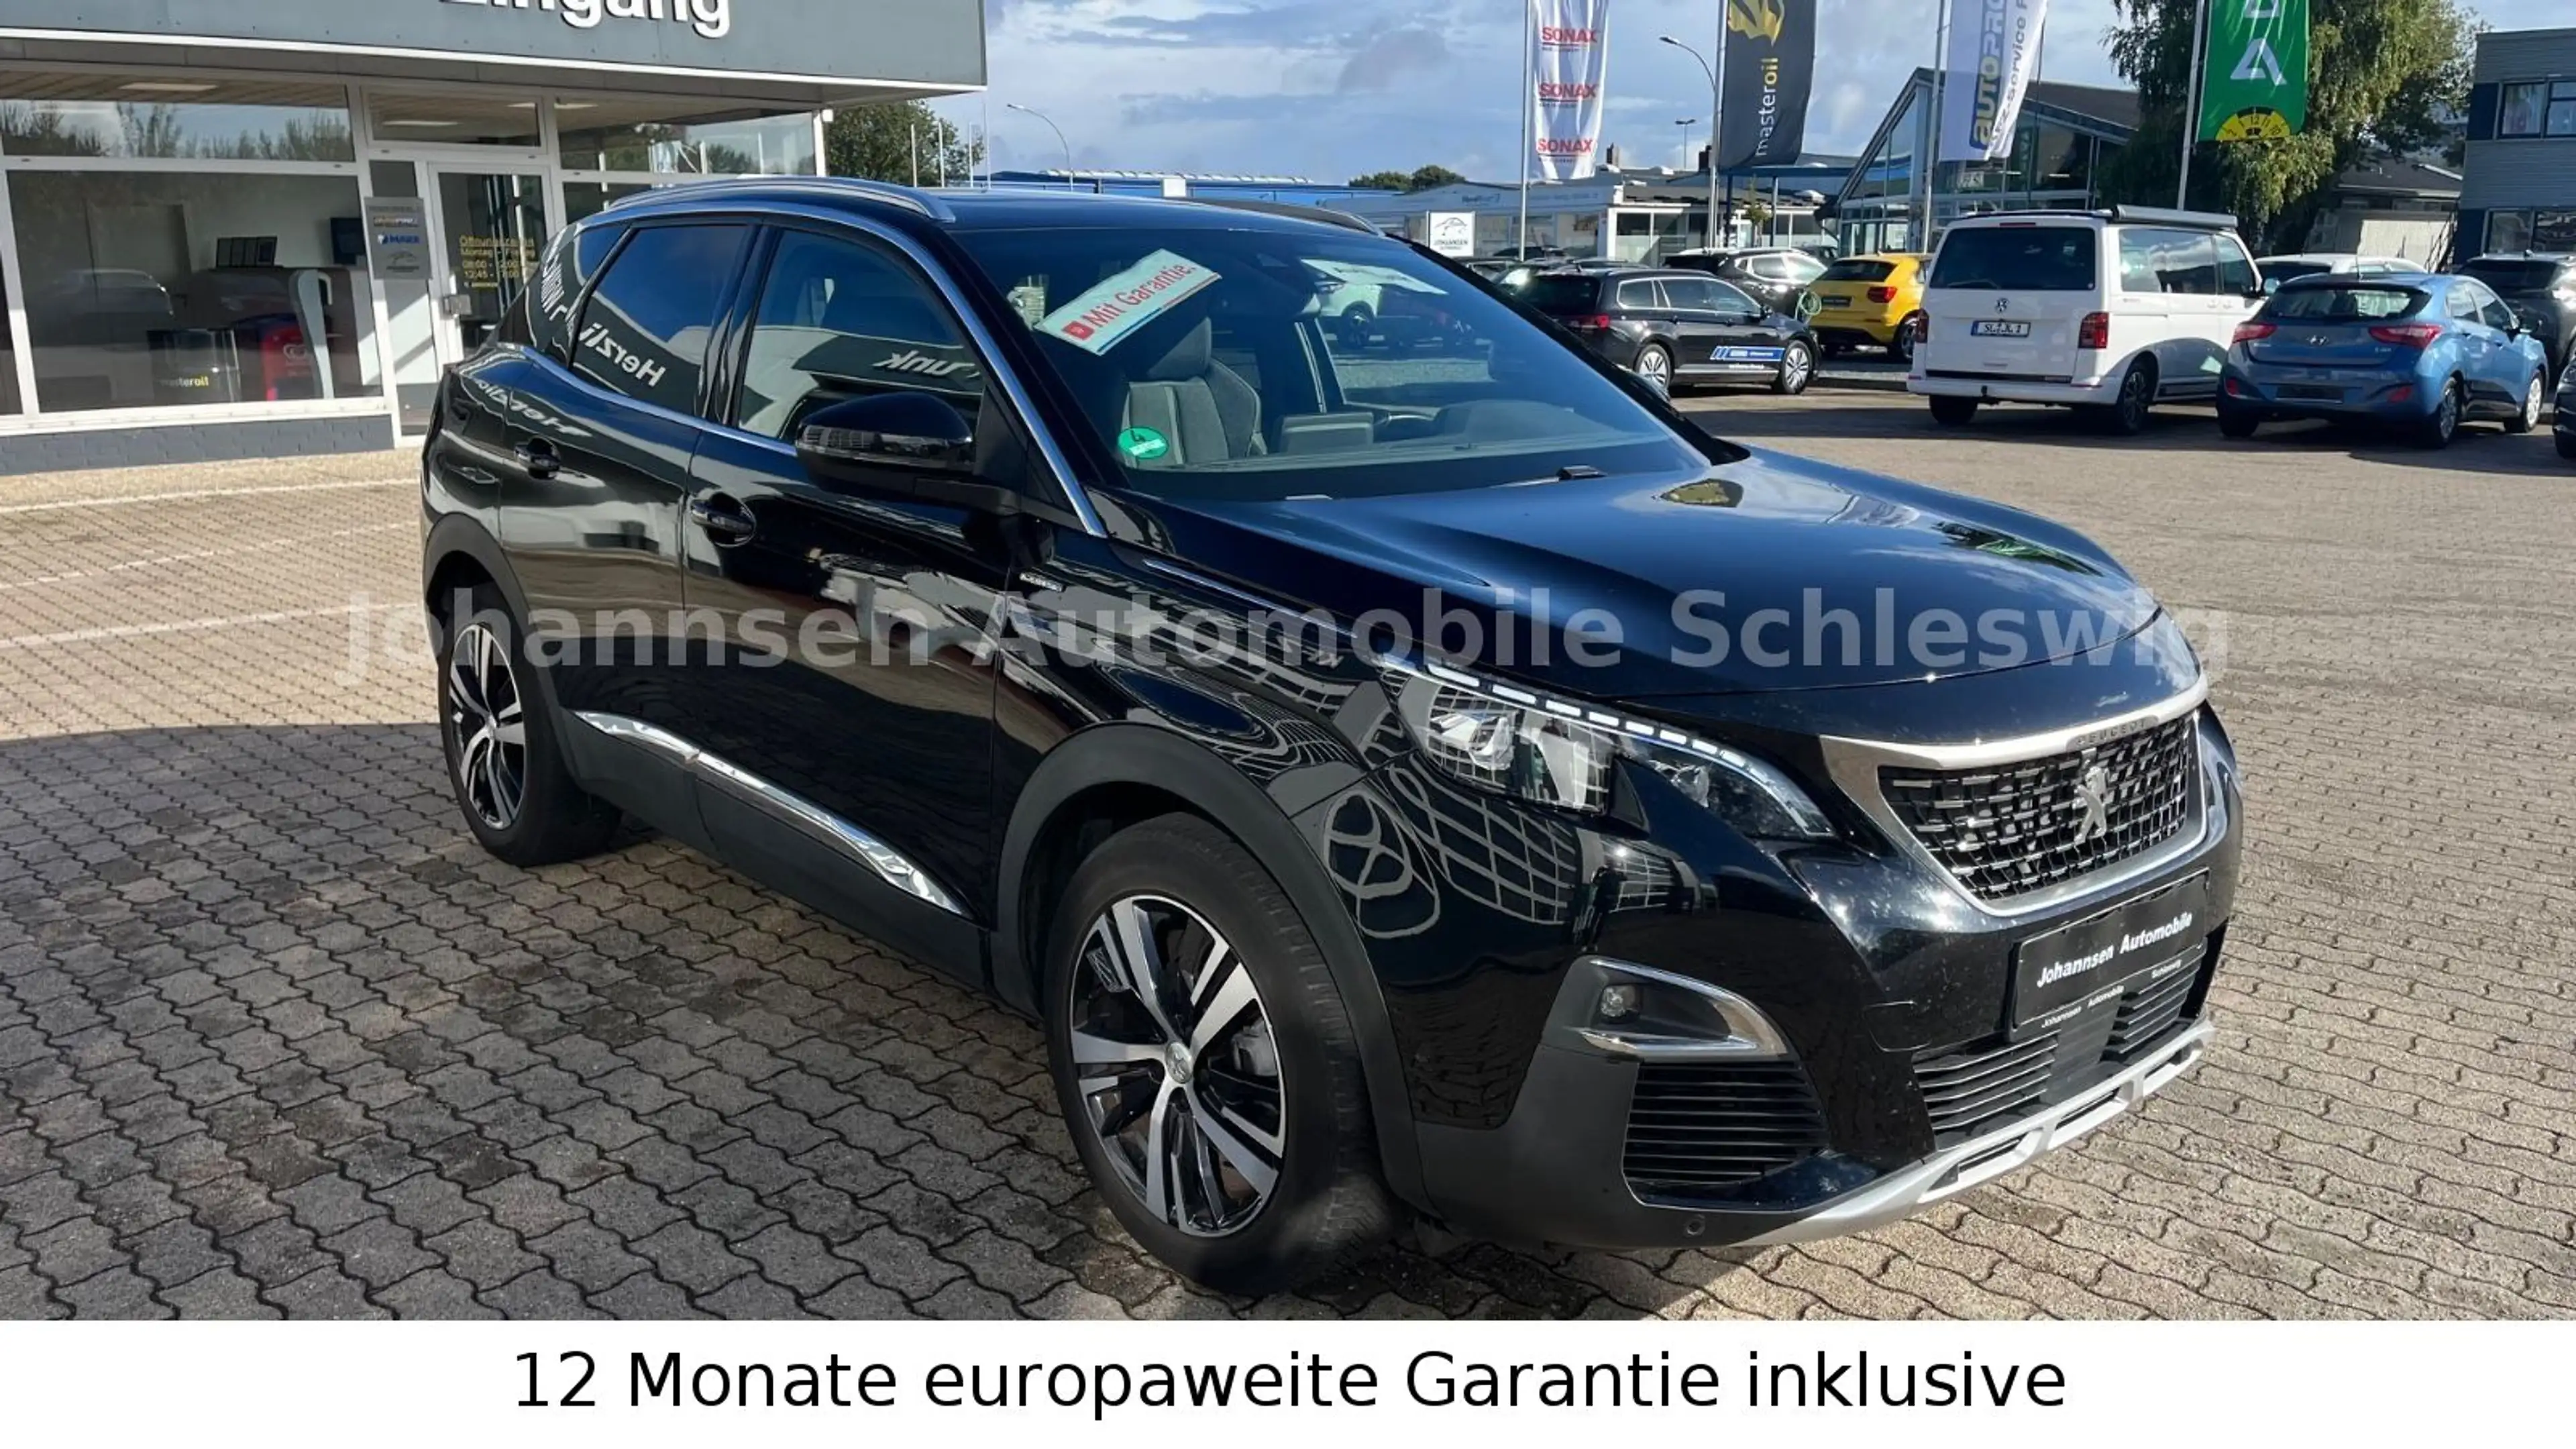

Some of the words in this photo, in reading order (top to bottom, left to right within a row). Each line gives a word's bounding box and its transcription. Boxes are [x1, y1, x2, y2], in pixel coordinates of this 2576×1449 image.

[441, 0, 731, 38] gang
[1542, 27, 1597, 43] SONAX
[1539, 82, 1599, 99] SONAX
[1755, 58, 1778, 156] masteroil
[1537, 138, 1593, 153] SONAX
[1081, 303, 1127, 328] Mit
[2077, 718, 2145, 744] PEUGEOT
[2037, 945, 2114, 987] Johannsen
[2120, 913, 2192, 954] Automobile
